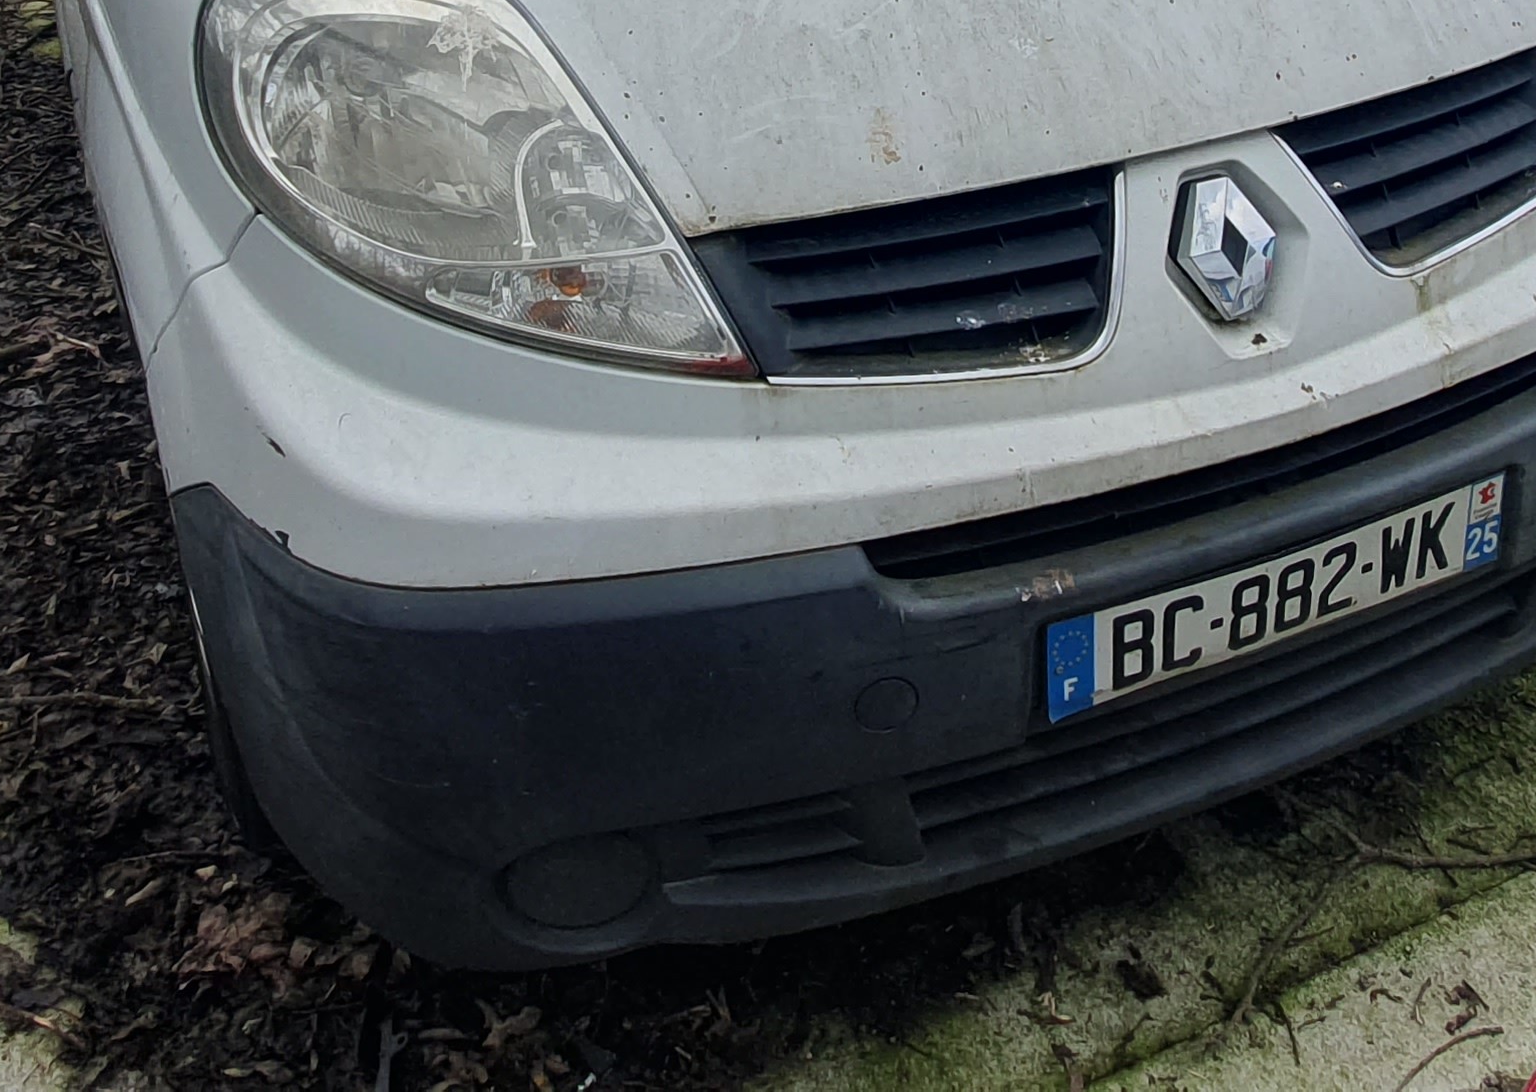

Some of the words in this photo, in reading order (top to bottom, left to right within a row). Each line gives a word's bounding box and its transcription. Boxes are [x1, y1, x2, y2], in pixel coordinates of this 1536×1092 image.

[1465, 520, 1498, 560] 25
[1112, 501, 1456, 692] BC-882-WK
[1063, 676, 1079, 702] F
